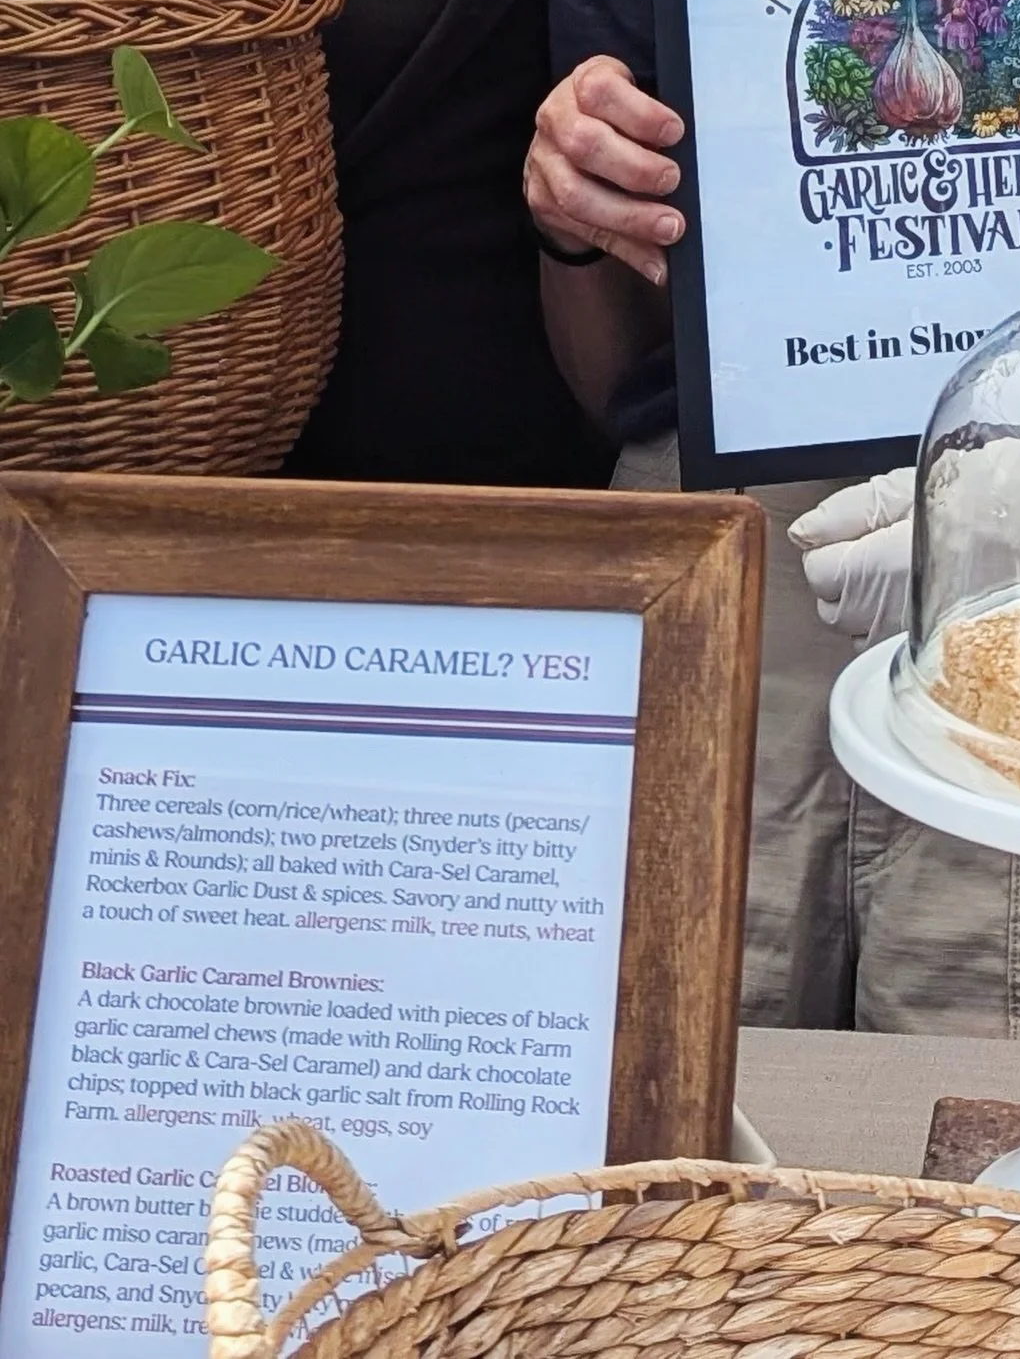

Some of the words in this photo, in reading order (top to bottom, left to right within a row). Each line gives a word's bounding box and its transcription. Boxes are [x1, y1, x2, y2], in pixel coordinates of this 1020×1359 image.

[800, 160, 918, 224] GARLIC
[944, 259, 982, 275] 2003
[784, 334, 861, 367] Best
[867, 329, 903, 359] in
[144, 637, 262, 668] GARLIC
[267, 644, 336, 670] AND
[344, 646, 514, 677] CARAMEL?
[523, 653, 591, 681] YES!
[99, 767, 157, 786] Snack
[163, 769, 196, 787] Fix:
[96, 794, 150, 812] Three
[156, 798, 222, 815] cereals
[228, 799, 399, 825] (corn/rice/wheat);
[404, 808, 452, 826] three
[458, 811, 499, 828] nuts
[506, 812, 590, 835] (pecans/
[92, 822, 274, 847] cashews/almonds);
[281, 831, 315, 846] two
[321, 833, 397, 851] pretzels
[497, 837, 526, 860] itty
[533, 840, 576, 862] bitty
[89, 850, 140, 866] minis
[145, 850, 159, 867] &
[165, 850, 248, 873] Rounds);
[253, 856, 274, 872] all
[280, 856, 336, 875] baked
[343, 860, 383, 877] with
[389, 861, 470, 881] Cara-Sel
[476, 865, 559, 887] Caramel,
[86, 874, 187, 895] Rockerbox
[193, 879, 248, 898] Garlic
[253, 882, 297, 900] Dust
[303, 884, 317, 902] &
[322, 887, 387, 906] spices.
[393, 888, 459, 911] Savory
[464, 893, 500, 910] and
[506, 896, 557, 916] nutty
[563, 897, 604, 915] with
[82, 905, 93, 918] a
[99, 903, 152, 921] touch
[158, 905, 179, 922] of
[182, 908, 237, 925] sweet
[243, 908, 289, 928] heat.
[295, 912, 386, 934] allergens:
[391, 916, 436, 936] milk,
[442, 920, 479, 937] tree
[484, 922, 531, 941] nuts,
[536, 924, 595, 942] wheat
[81, 961, 135, 981] Black
[140, 964, 198, 984] Garlic
[202, 967, 284, 988] Caramel
[288, 971, 385, 992] Brownies:
[77, 990, 92, 1007] A
[98, 991, 141, 1009] dark
[145, 993, 239, 1014] chocolate
[244, 996, 322, 1018] brownie
[327, 1001, 393, 1021] loaded
[398, 1004, 440, 1024] with
[444, 1007, 507, 1028] pieces
[512, 1009, 533, 1027] of
[538, 1011, 590, 1031] black
[74, 1018, 128, 1038] garlic
[133, 1021, 209, 1041] caramel
[214, 1024, 276, 1043] chews
[281, 1026, 342, 1046] (made
[348, 1031, 390, 1048] with
[395, 1031, 462, 1056] Rolling
[467, 1035, 516, 1056] Rock
[521, 1038, 572, 1058] Farm
[71, 1044, 123, 1065] black
[127, 1049, 181, 1069] garlic
[186, 1051, 200, 1068] &
[204, 1051, 288, 1072] Cara-Sel
[293, 1055, 380, 1079] Caramel)
[385, 1061, 422, 1079] and
[427, 1062, 472, 1082] dark
[476, 1064, 571, 1086] chocolate
[67, 1072, 125, 1096] chips;
[130, 1078, 198, 1099] topped
[202, 1080, 245, 1099] with
[249, 1081, 301, 1101] black
[306, 1085, 360, 1106] garlic
[365, 1088, 401, 1106] salt
[406, 1089, 453, 1109] from
[458, 1091, 526, 1117] Rolling
[531, 1095, 580, 1115] Rock
[64, 1101, 119, 1121] Farm.
[124, 1104, 217, 1128] allergens:
[341, 1117, 392, 1137] eggs,
[398, 1121, 433, 1140] soy
[50, 1163, 131, 1184] Roasted
[136, 1166, 194, 1188] Garlic
[46, 1192, 62, 1209] A
[67, 1193, 129, 1213] brown
[135, 1196, 194, 1216] butter
[277, 1204, 346, 1224] studde
[480, 1214, 502, 1232] of
[43, 1222, 98, 1242] garlic
[103, 1225, 150, 1242] miso
[39, 1251, 98, 1272] garlic,
[104, 1252, 188, 1274] Cara-Sel
[280, 1261, 294, 1280] &
[35, 1282, 111, 1303] pecans,
[116, 1284, 153, 1302] and
[31, 1308, 127, 1332] allergens:
[130, 1315, 177, 1336] milk,
